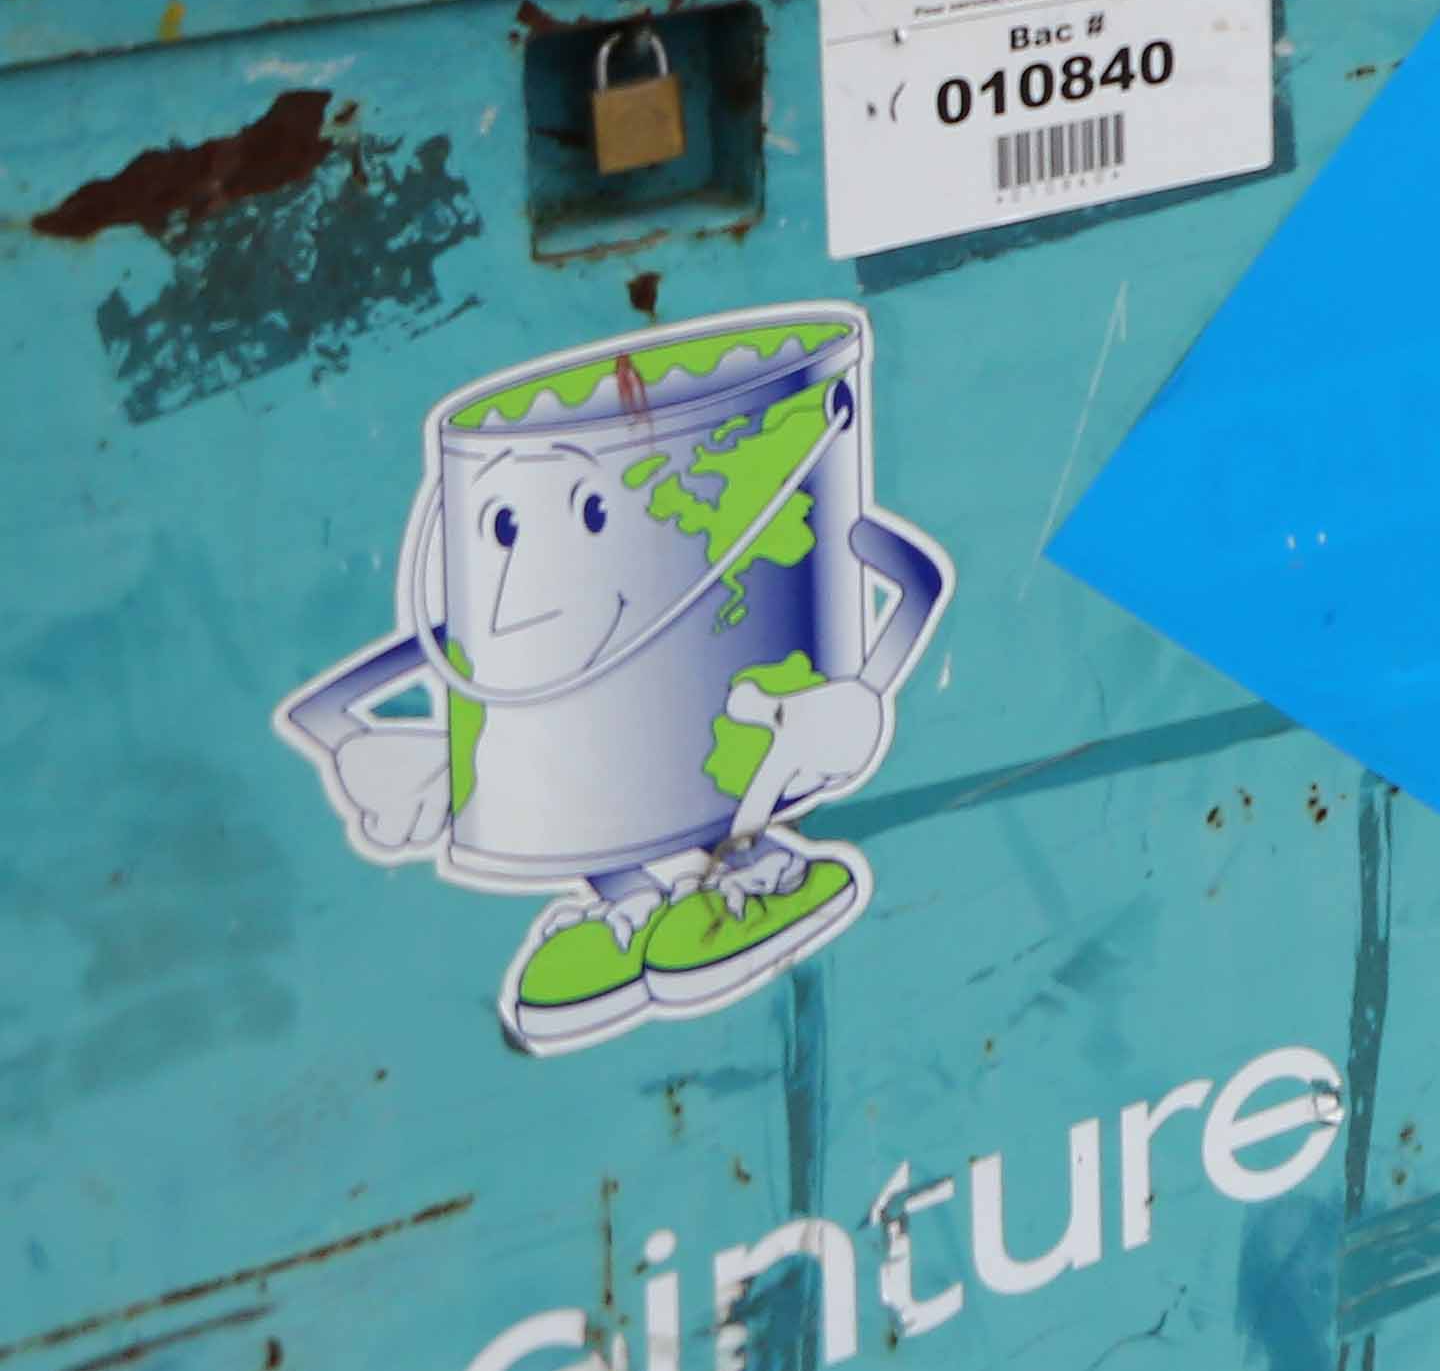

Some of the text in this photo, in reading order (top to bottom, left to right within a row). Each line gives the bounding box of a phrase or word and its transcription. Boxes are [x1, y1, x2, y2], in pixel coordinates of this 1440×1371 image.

[1009, 12, 1105, 52] Bac #
[936, 39, 1174, 125] 010840
